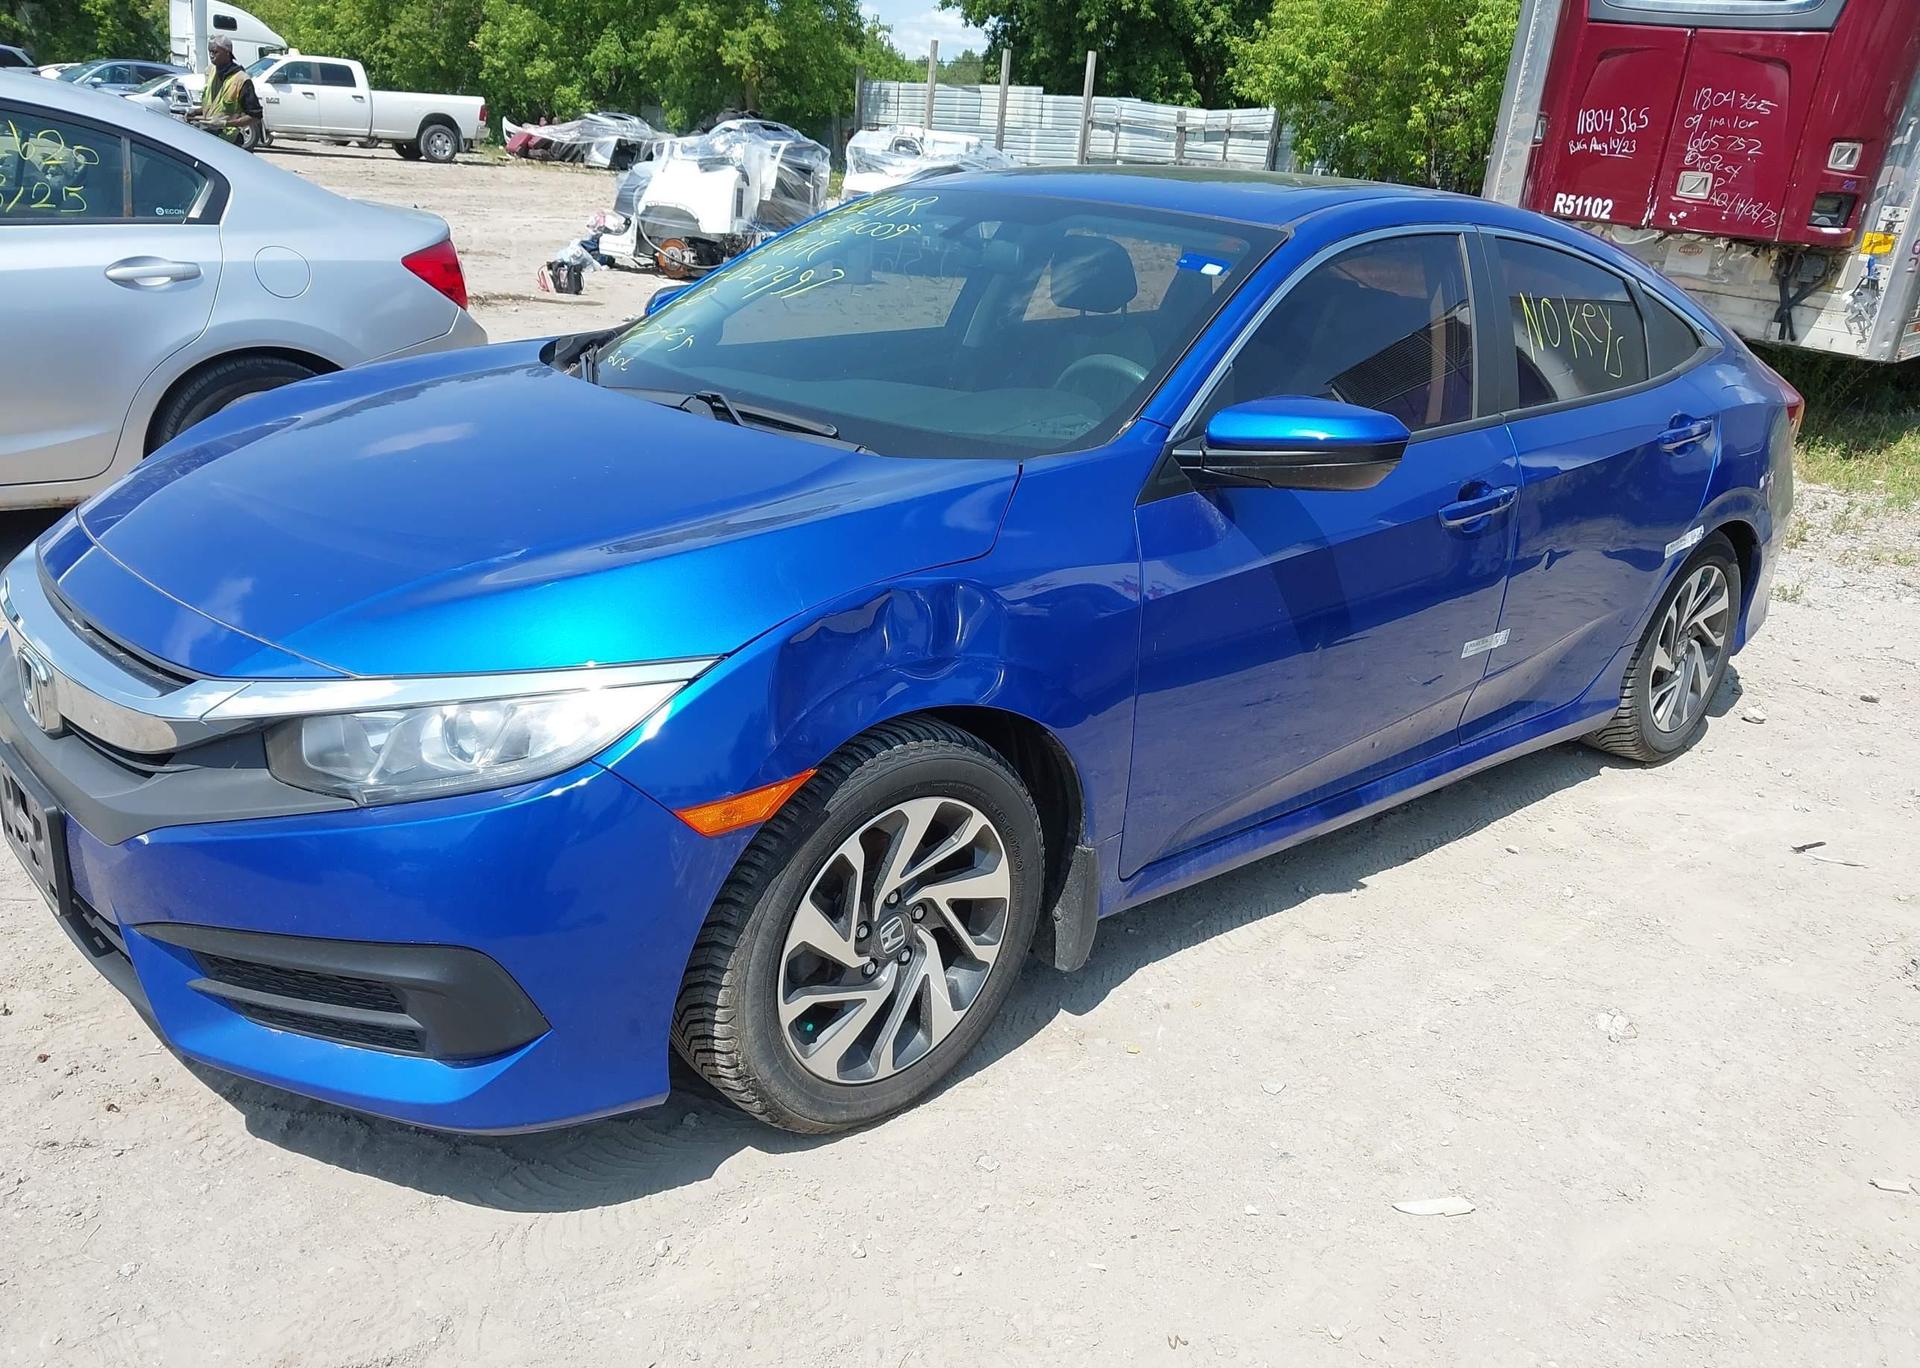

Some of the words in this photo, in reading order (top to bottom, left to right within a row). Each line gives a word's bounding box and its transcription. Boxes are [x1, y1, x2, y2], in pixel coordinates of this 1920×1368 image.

[1692, 88, 1778, 115] 11804365
[1577, 106, 1649, 135] 11804365
[1553, 192, 1614, 220] R51102
[1519, 291, 1562, 364] NO
